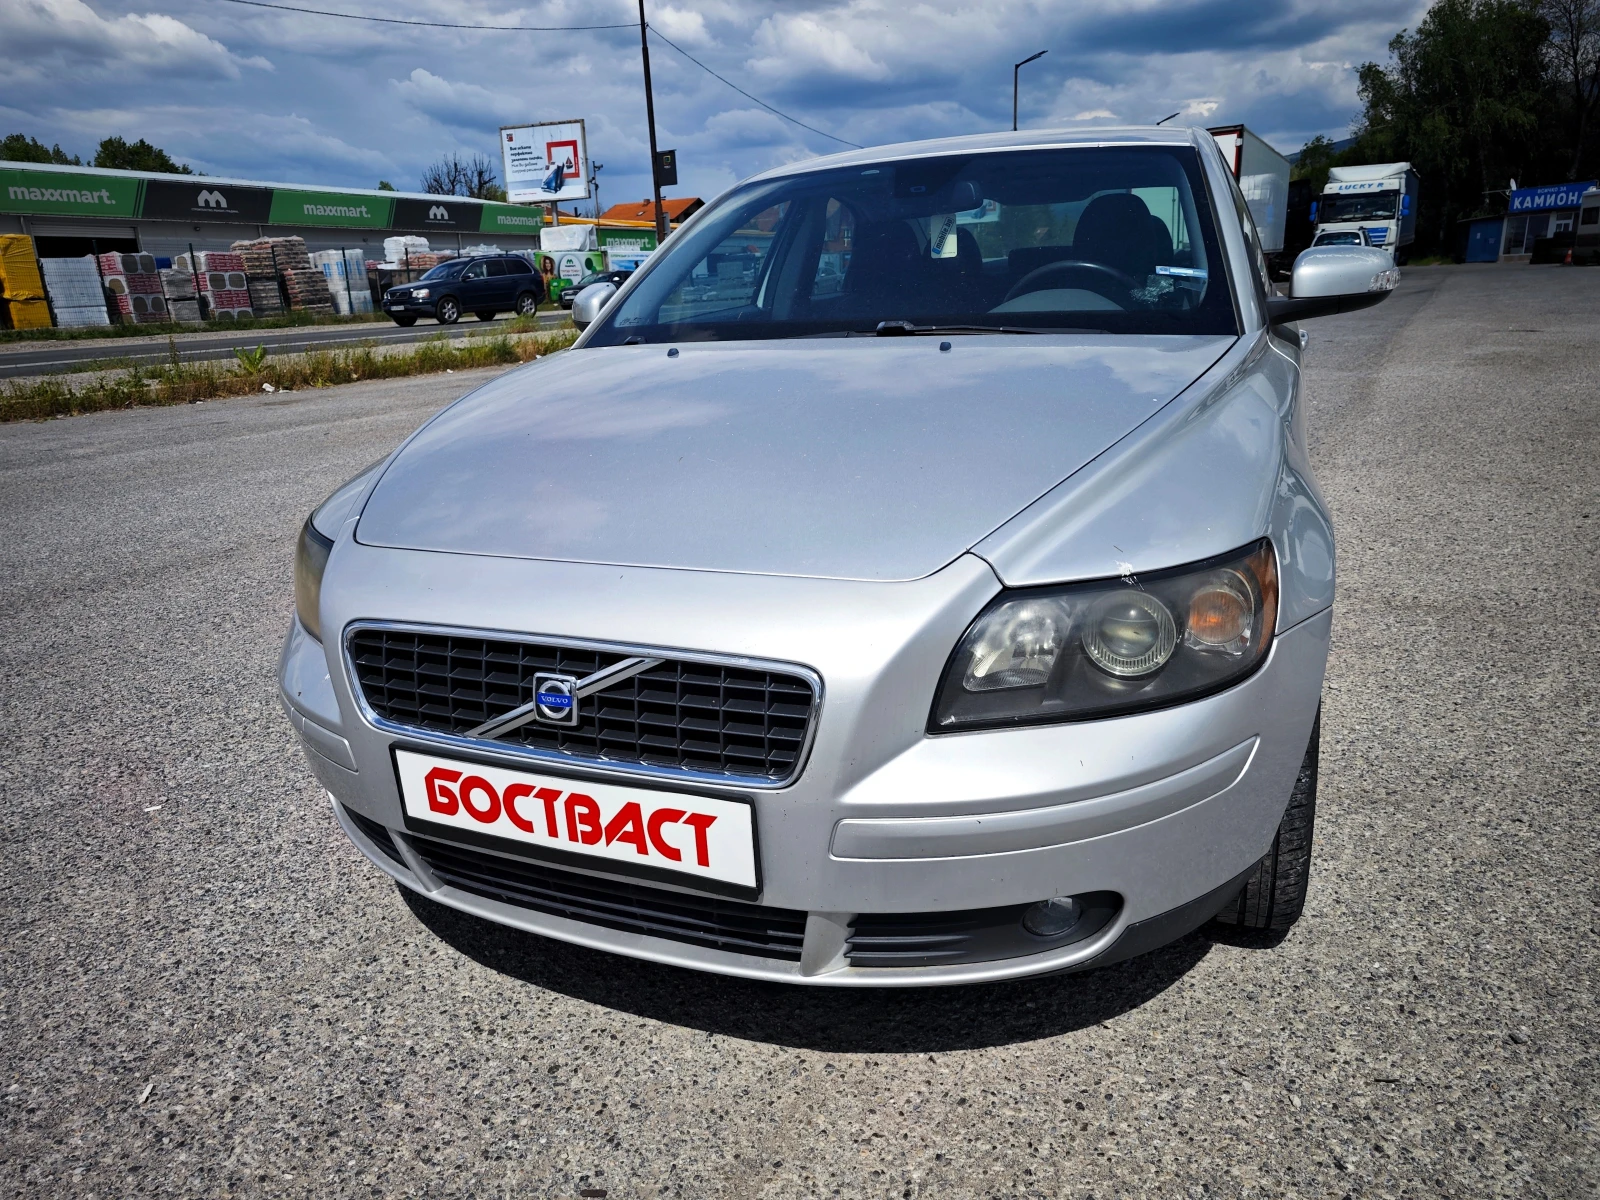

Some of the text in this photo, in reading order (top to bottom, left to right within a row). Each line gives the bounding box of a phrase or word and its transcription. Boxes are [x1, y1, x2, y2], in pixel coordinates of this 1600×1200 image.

[8, 185, 116, 205] maxxmart.
[1513, 191, 1583, 209] КАМИОН
[303, 203, 371, 218] maxxmart.
[497, 214, 543, 226] maxxmart.
[606, 236, 651, 248] maxxmart.
[540, 696, 569, 704] VOLVO
[425, 767, 718, 868] БОСТВАСТ
